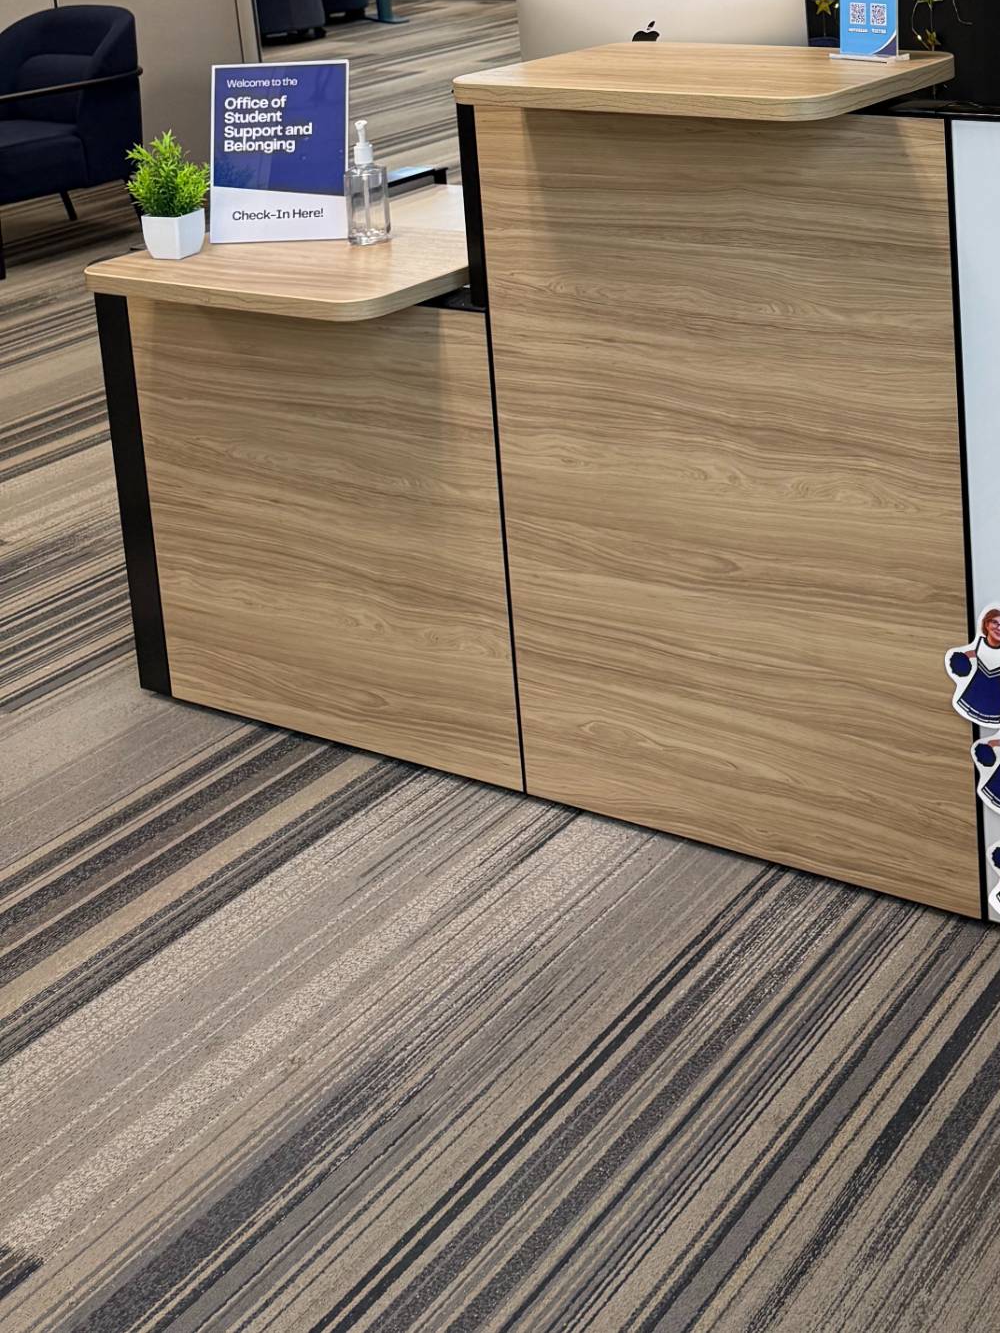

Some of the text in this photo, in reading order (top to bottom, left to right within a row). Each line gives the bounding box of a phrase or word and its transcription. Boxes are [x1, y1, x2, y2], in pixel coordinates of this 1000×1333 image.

[226, 78, 270, 88] Welcome
[282, 77, 298, 86] the
[224, 95, 287, 110] Office of
[224, 110, 282, 124] Student
[224, 122, 313, 140] Support and
[224, 138, 296, 153] Belonging
[232, 208, 324, 221] Check-In Here!
